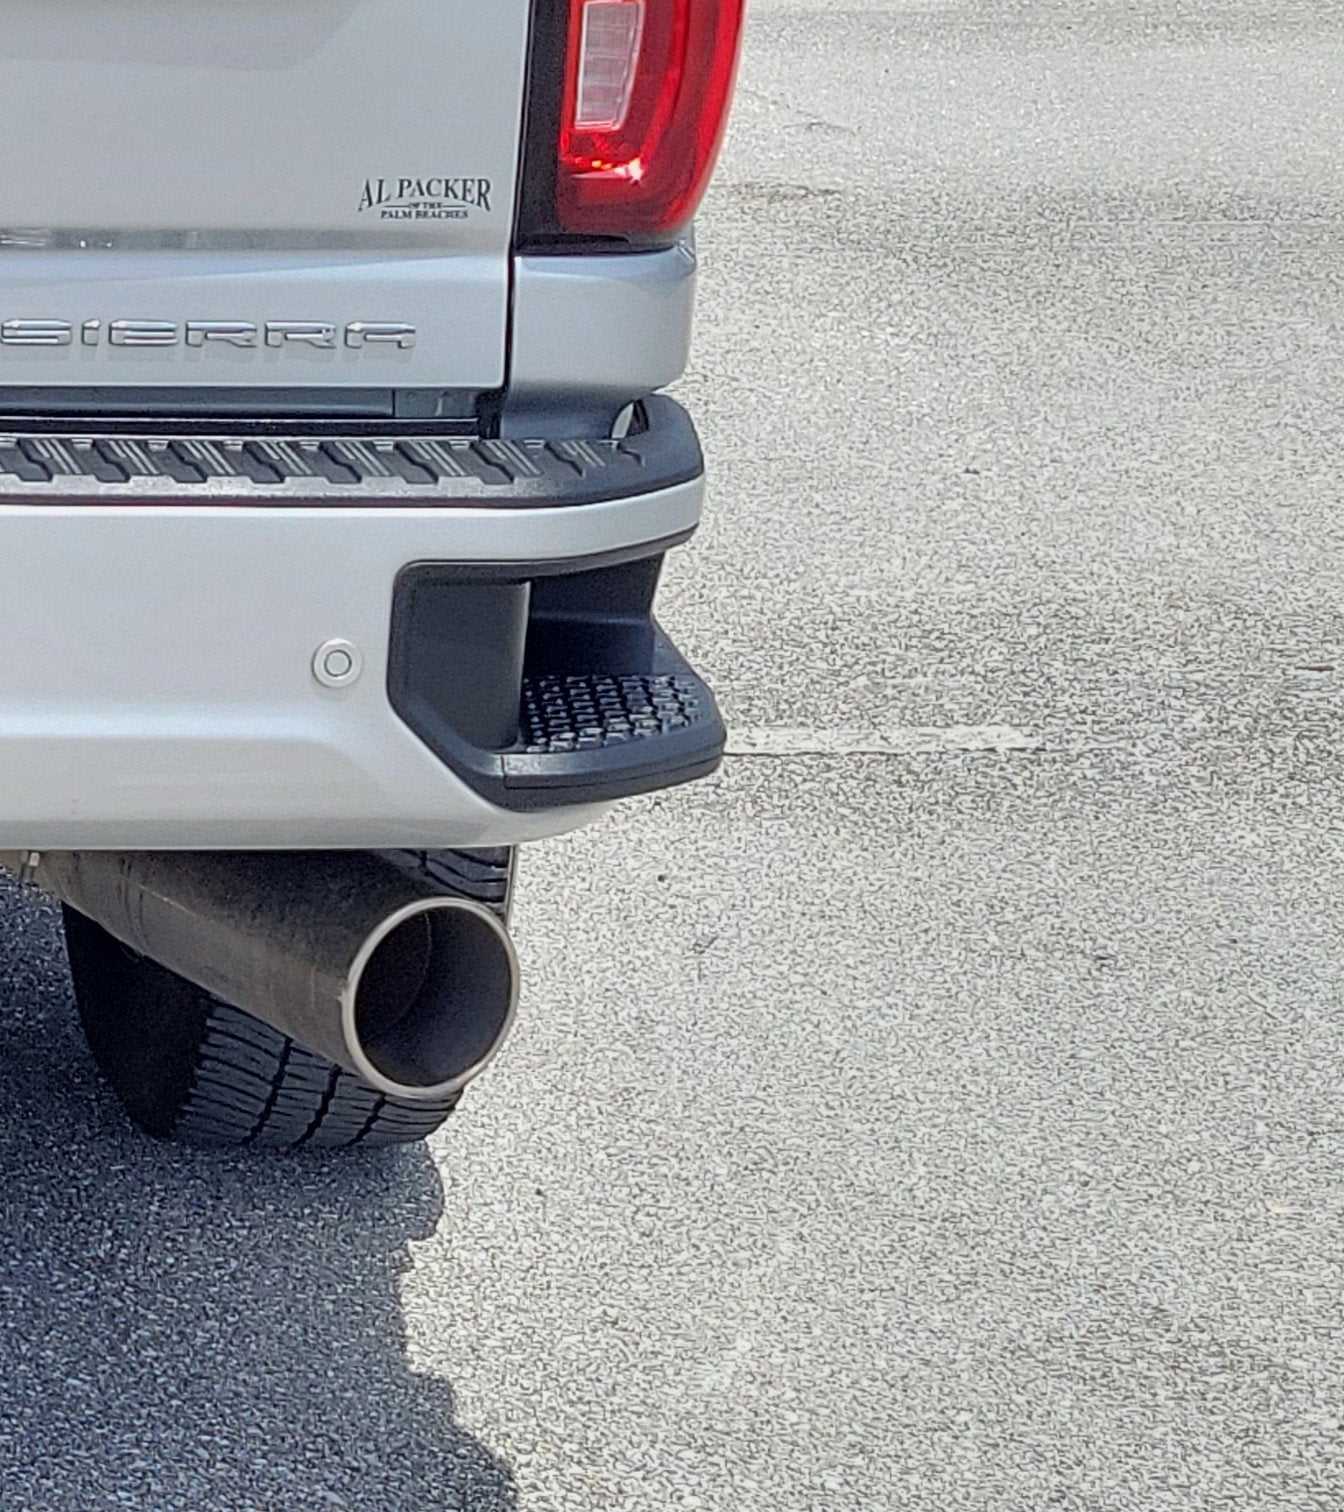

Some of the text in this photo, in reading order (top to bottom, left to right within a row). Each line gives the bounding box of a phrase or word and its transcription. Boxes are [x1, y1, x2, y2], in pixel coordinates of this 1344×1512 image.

[358, 178, 491, 211] AL PACKER
[381, 210, 468, 219] PALM BEACHES
[0, 318, 415, 349] SIERRA
